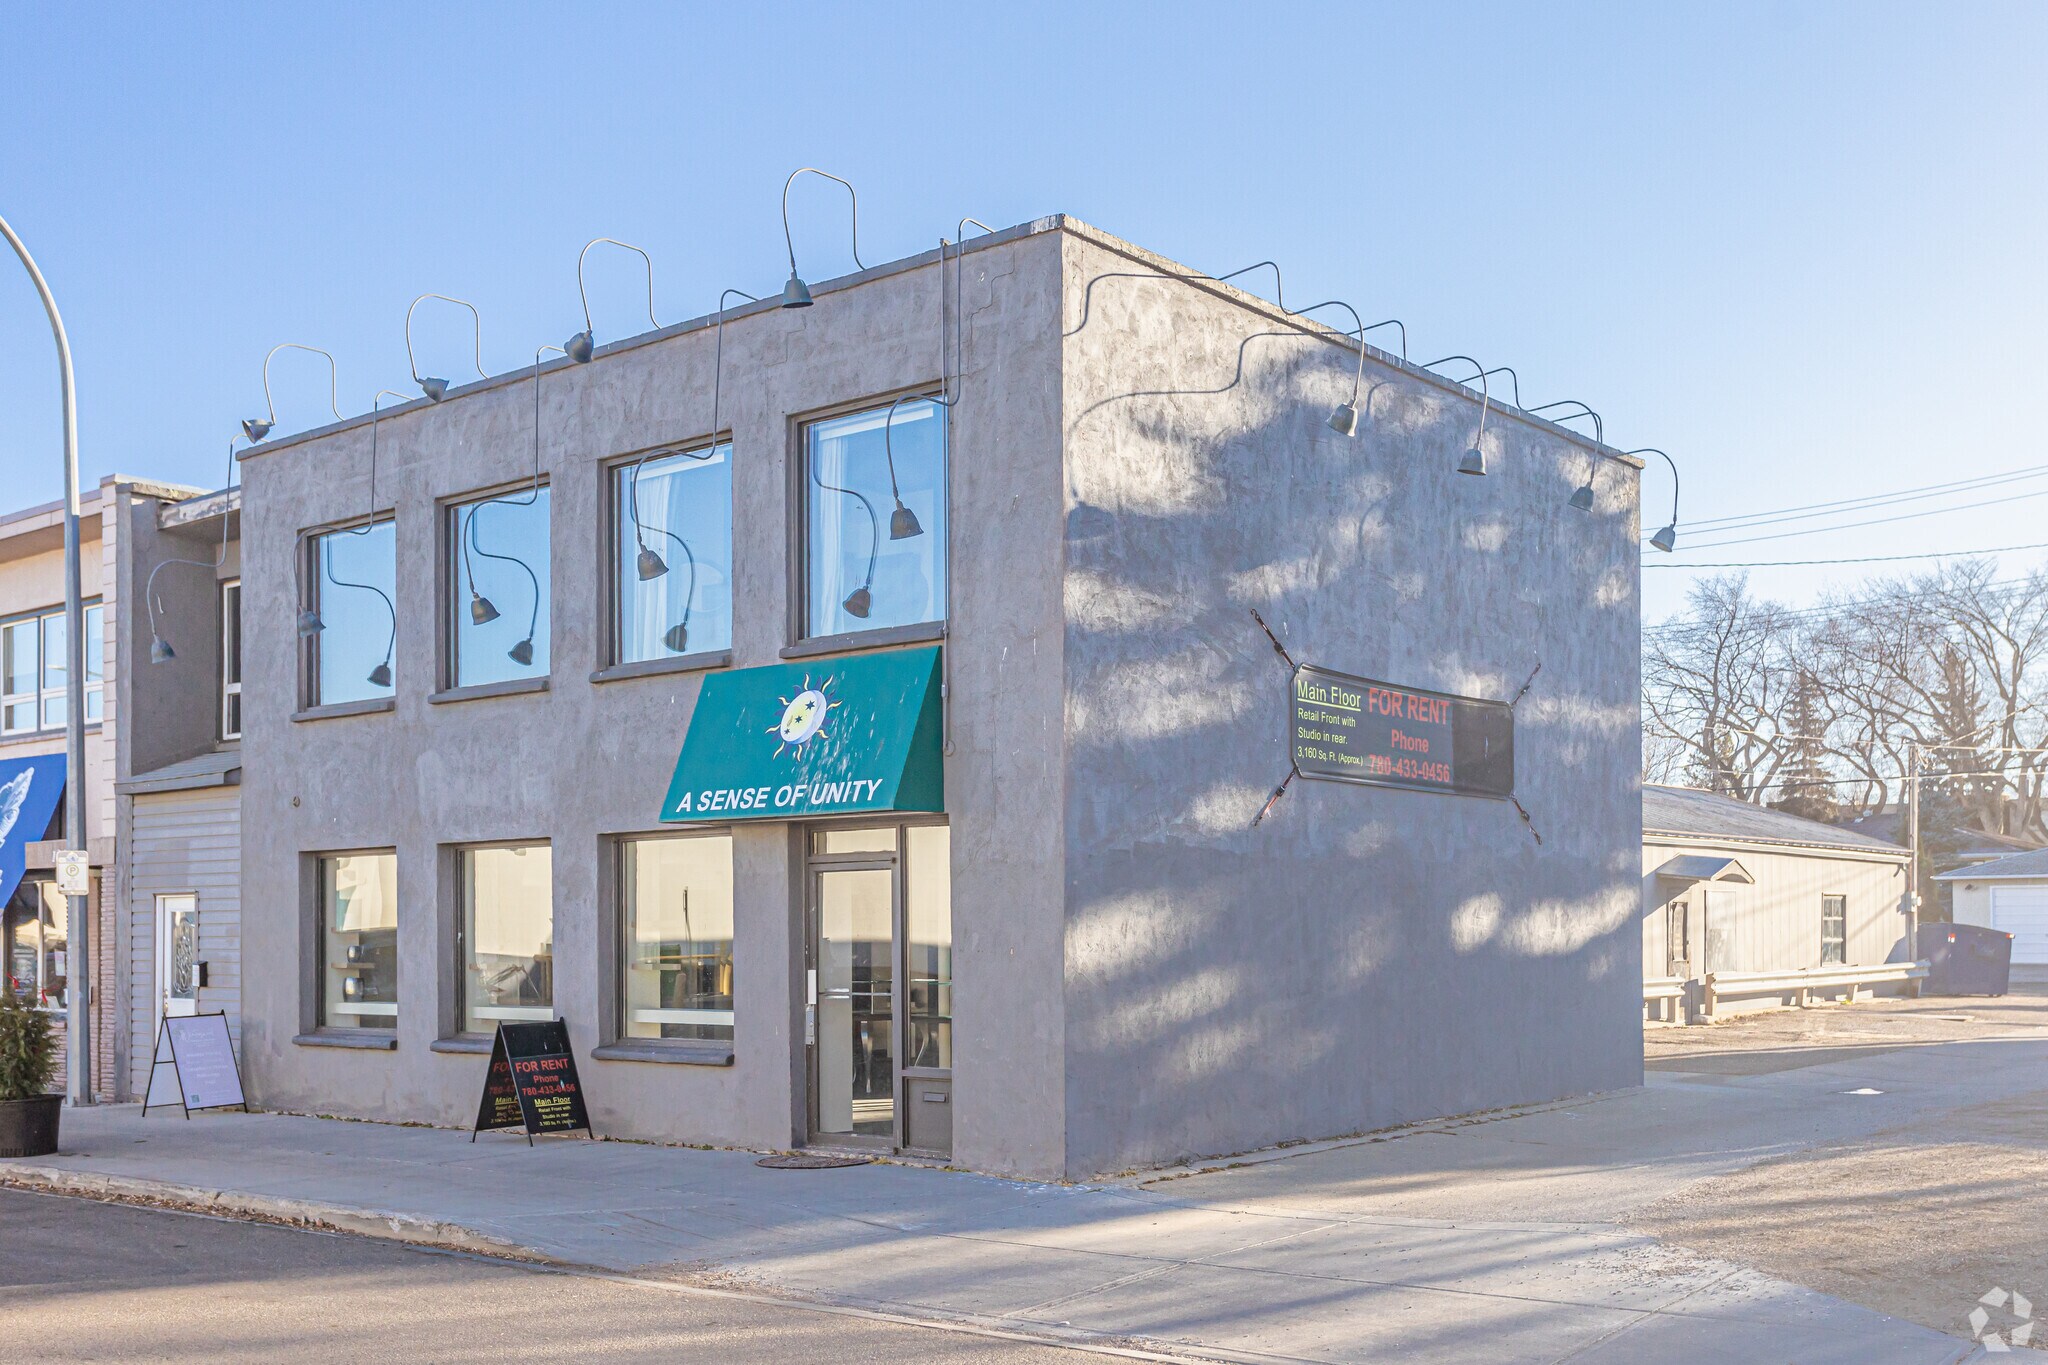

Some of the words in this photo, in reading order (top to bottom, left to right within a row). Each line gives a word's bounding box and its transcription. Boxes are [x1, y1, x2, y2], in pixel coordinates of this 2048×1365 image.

[1297, 679, 1327, 702] Main
[1331, 686, 1361, 708] Floor
[1369, 687, 1403, 718] FOR
[1408, 694, 1450, 725] RENT
[1298, 707, 1320, 722] Retail
[1321, 711, 1340, 725] Front
[1342, 716, 1356, 728] with
[1298, 726, 1321, 741] Studio
[1323, 730, 1330, 742] in
[1332, 734, 1348, 745] rear.
[1391, 728, 1430, 753] Phone
[1298, 745, 1317, 759] 3,160
[1318, 749, 1328, 762] Sq.
[1338, 752, 1364, 767] (Approx.)
[1368, 753, 1451, 783] 780-433-0456
[675, 791, 692, 812] A
[696, 786, 771, 812] SENSE
[774, 784, 808, 807] OF
[810, 778, 883, 805] UNITY
[515, 1060, 540, 1073] FOR
[540, 1058, 568, 1071] RENT
[533, 1074, 560, 1084] Phone
[534, 1098, 551, 1106] Main
[552, 1096, 571, 1104] Floor
